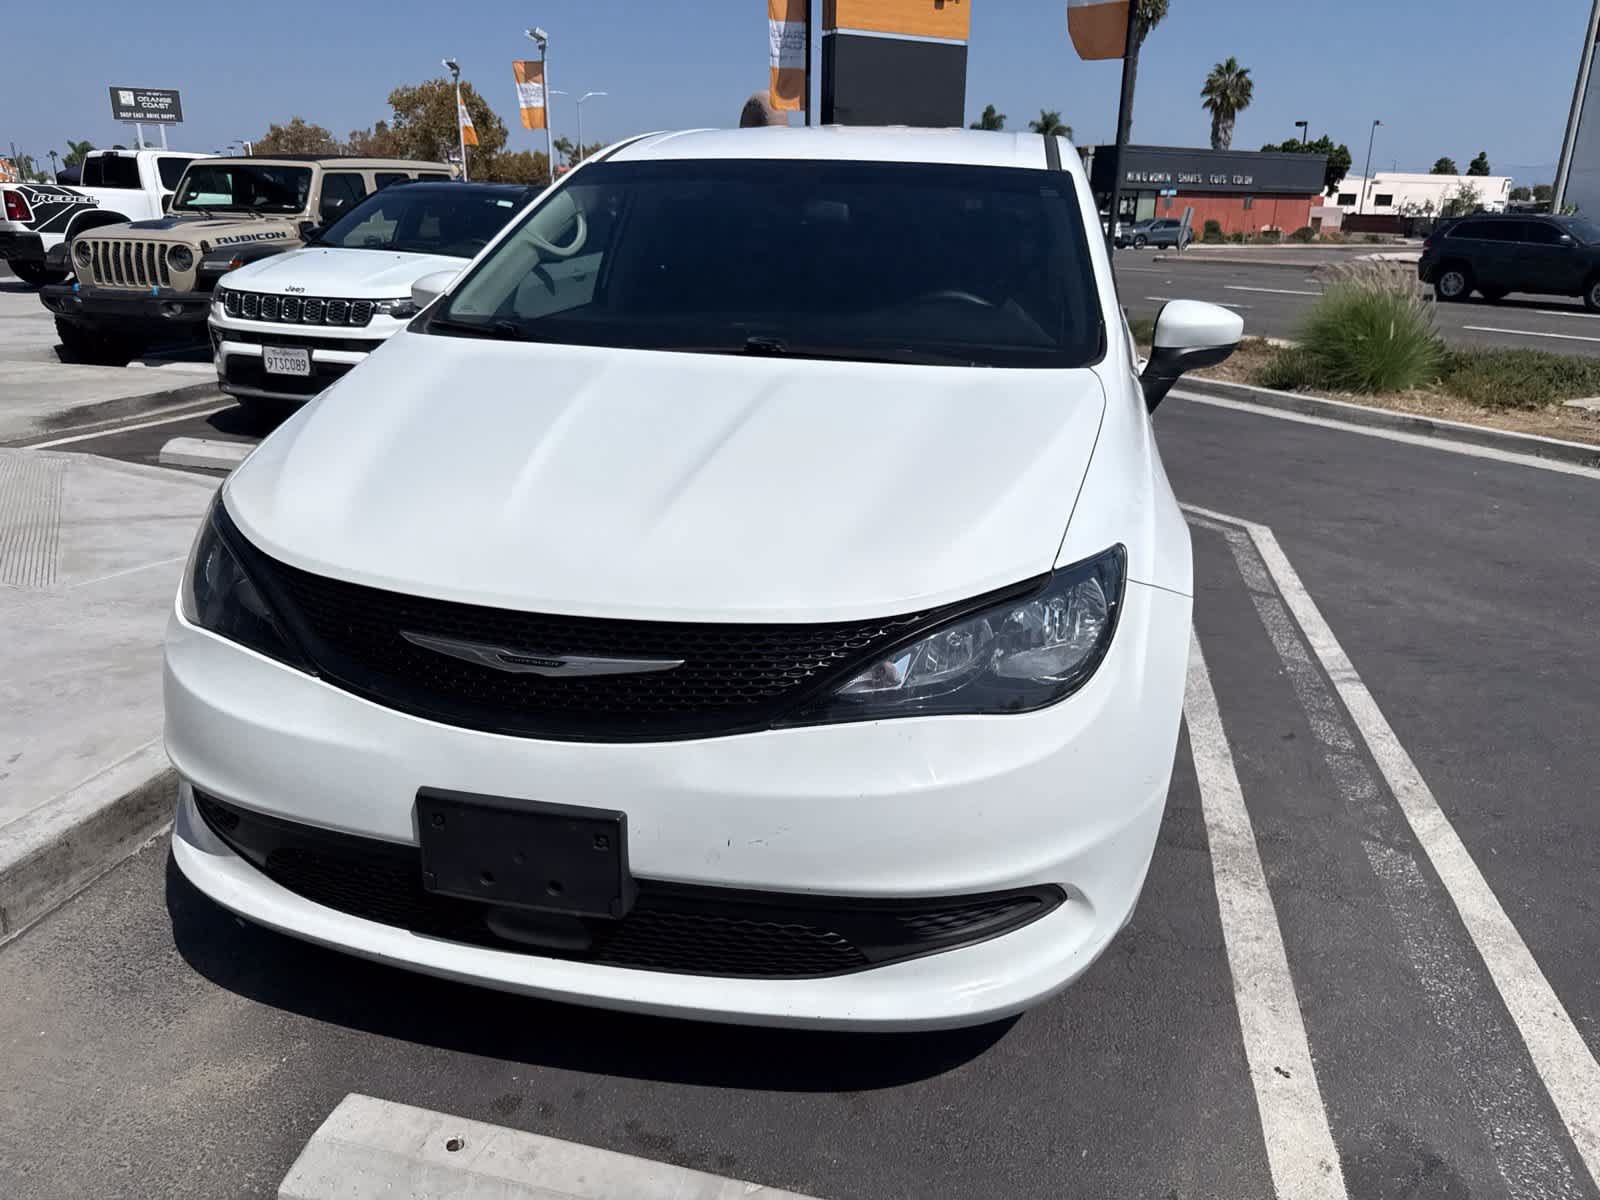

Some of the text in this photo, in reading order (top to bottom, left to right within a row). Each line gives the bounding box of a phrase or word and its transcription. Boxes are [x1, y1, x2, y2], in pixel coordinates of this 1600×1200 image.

[1177, 173, 1203, 184] SHAVES
[1209, 174, 1227, 184] CUTS
[1232, 175, 1253, 184] COLOR
[32, 192, 100, 205] REBEL
[215, 232, 287, 245] RUBICON
[285, 285, 305, 293] Jeep
